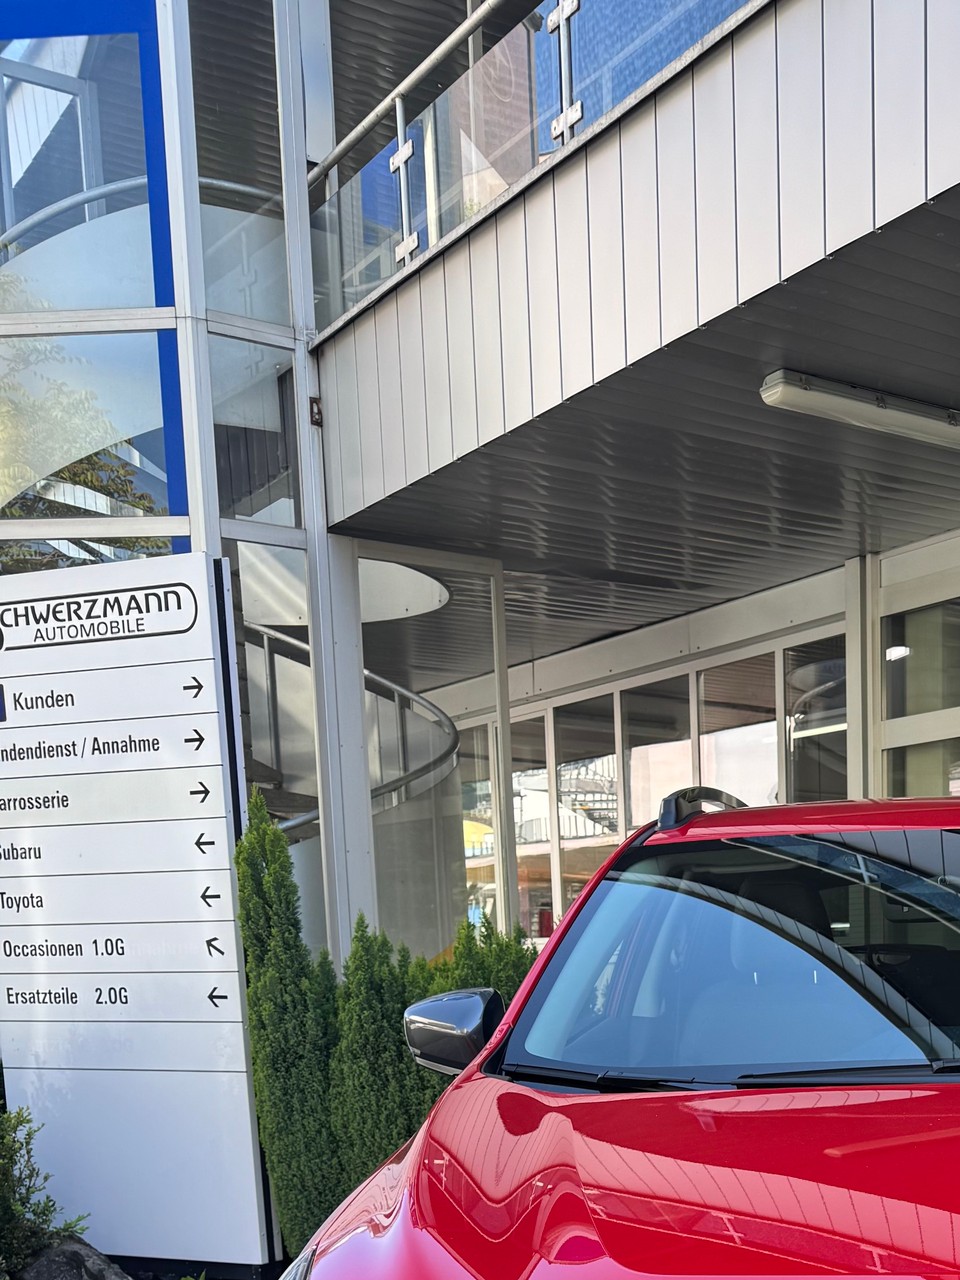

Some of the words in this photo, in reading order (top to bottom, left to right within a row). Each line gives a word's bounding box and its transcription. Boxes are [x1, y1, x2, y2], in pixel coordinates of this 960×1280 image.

[0, 589, 182, 630] CHWERZMANN
[33, 617, 145, 642] AUTOMOBILE
[13, 689, 75, 711] Kunden
[0, 740, 77, 762] ndendienst
[81, 737, 87, 759] /
[91, 734, 160, 756] Annahme
[0, 790, 69, 811] arrosserie
[0, 892, 44, 913] Toyota
[3, 939, 83, 957] Occasionen
[6, 987, 78, 1005] Ersatzteile
